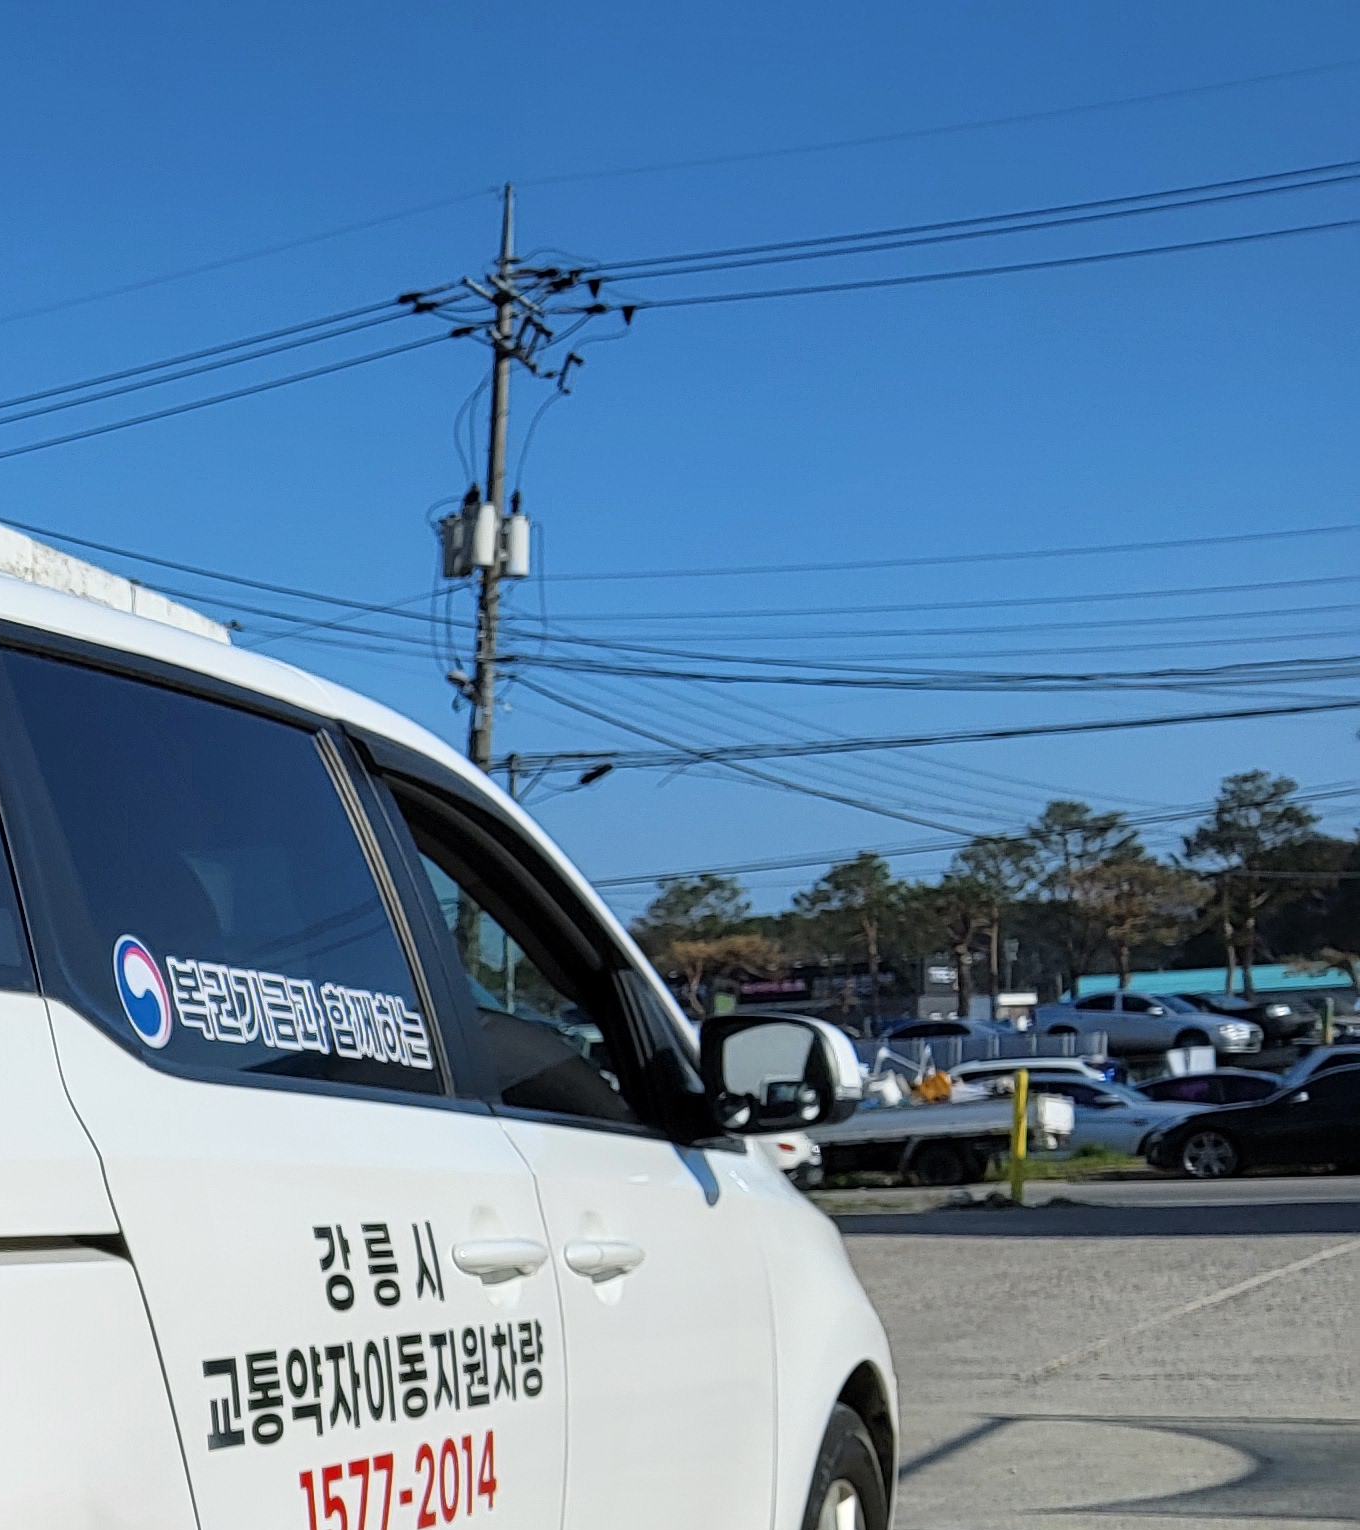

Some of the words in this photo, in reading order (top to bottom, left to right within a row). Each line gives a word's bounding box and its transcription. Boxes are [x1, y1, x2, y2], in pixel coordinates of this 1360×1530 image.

[166, 956, 330, 1055] 복권기금과
[320, 981, 434, 1070] 함께하는
[202, 1319, 543, 1452] 교통약자이동지원차량
